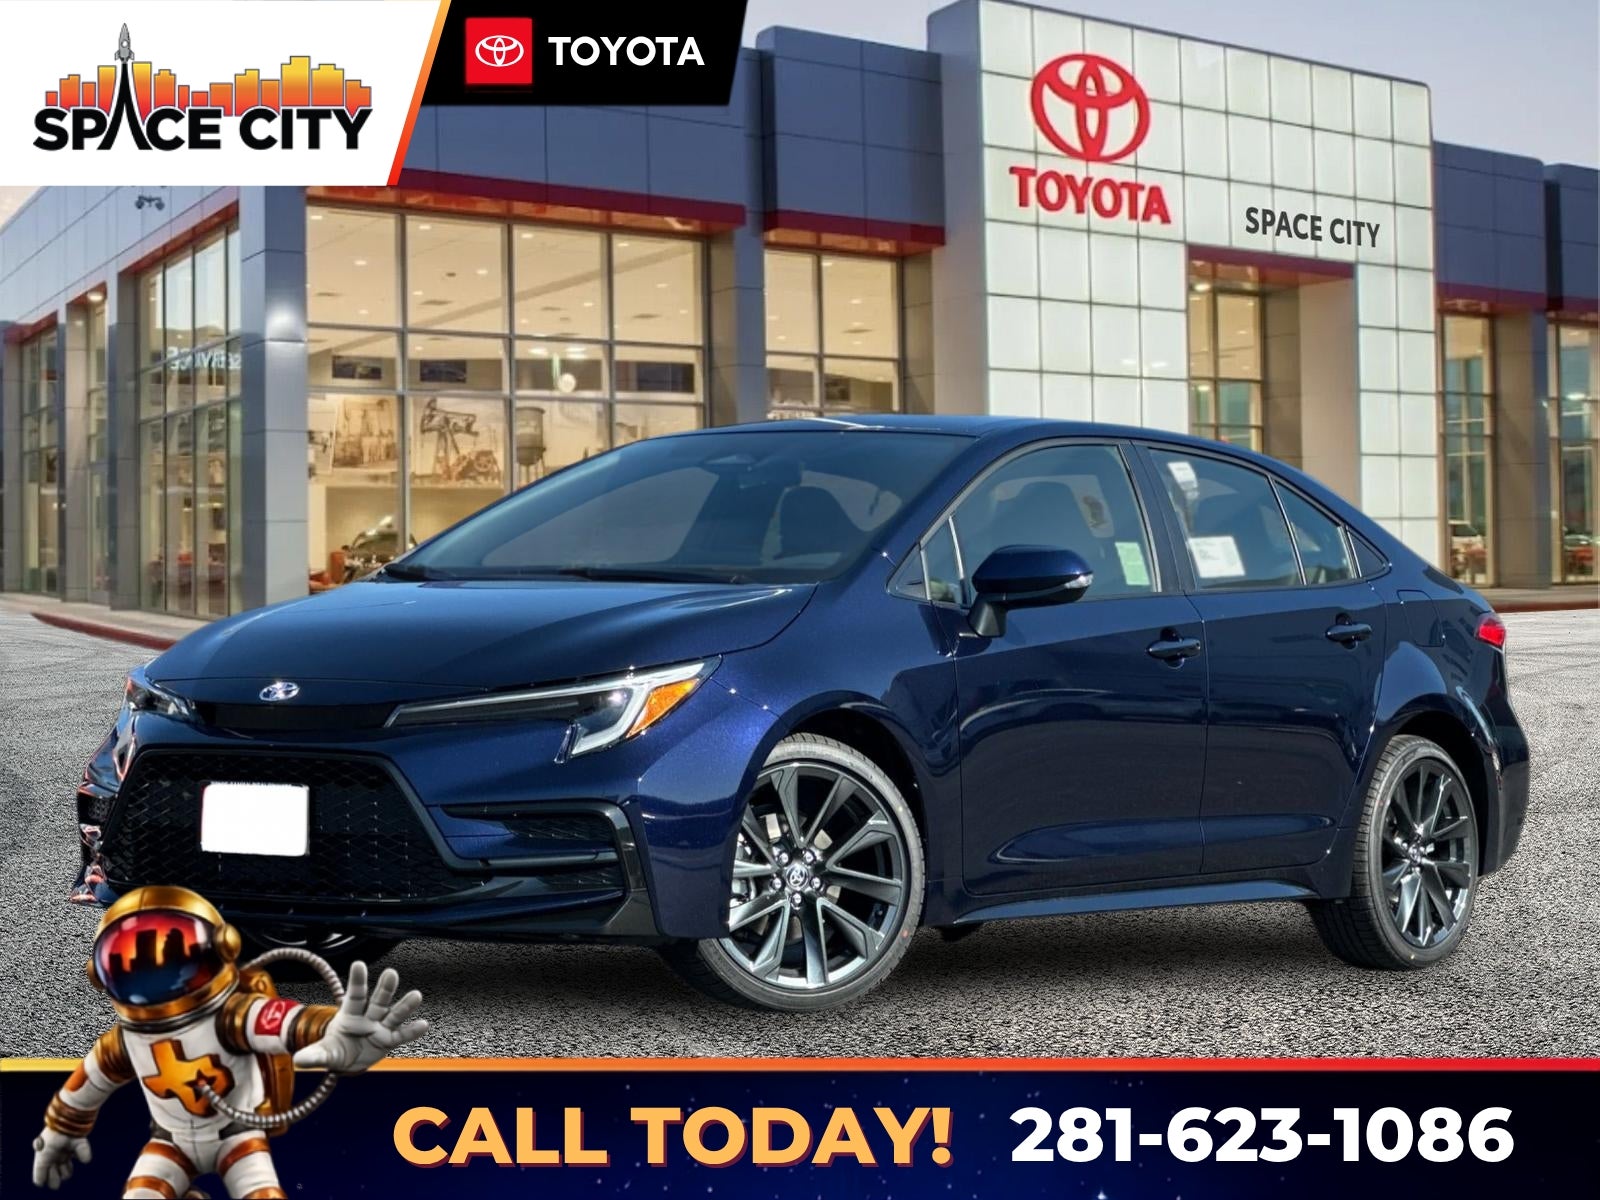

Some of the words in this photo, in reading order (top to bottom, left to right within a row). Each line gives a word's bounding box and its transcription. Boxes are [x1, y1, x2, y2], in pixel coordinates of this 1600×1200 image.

[1009, 167, 1170, 224] TOYOTA
[1245, 206, 1323, 241] SPACE
[1329, 217, 1381, 248] CITY
